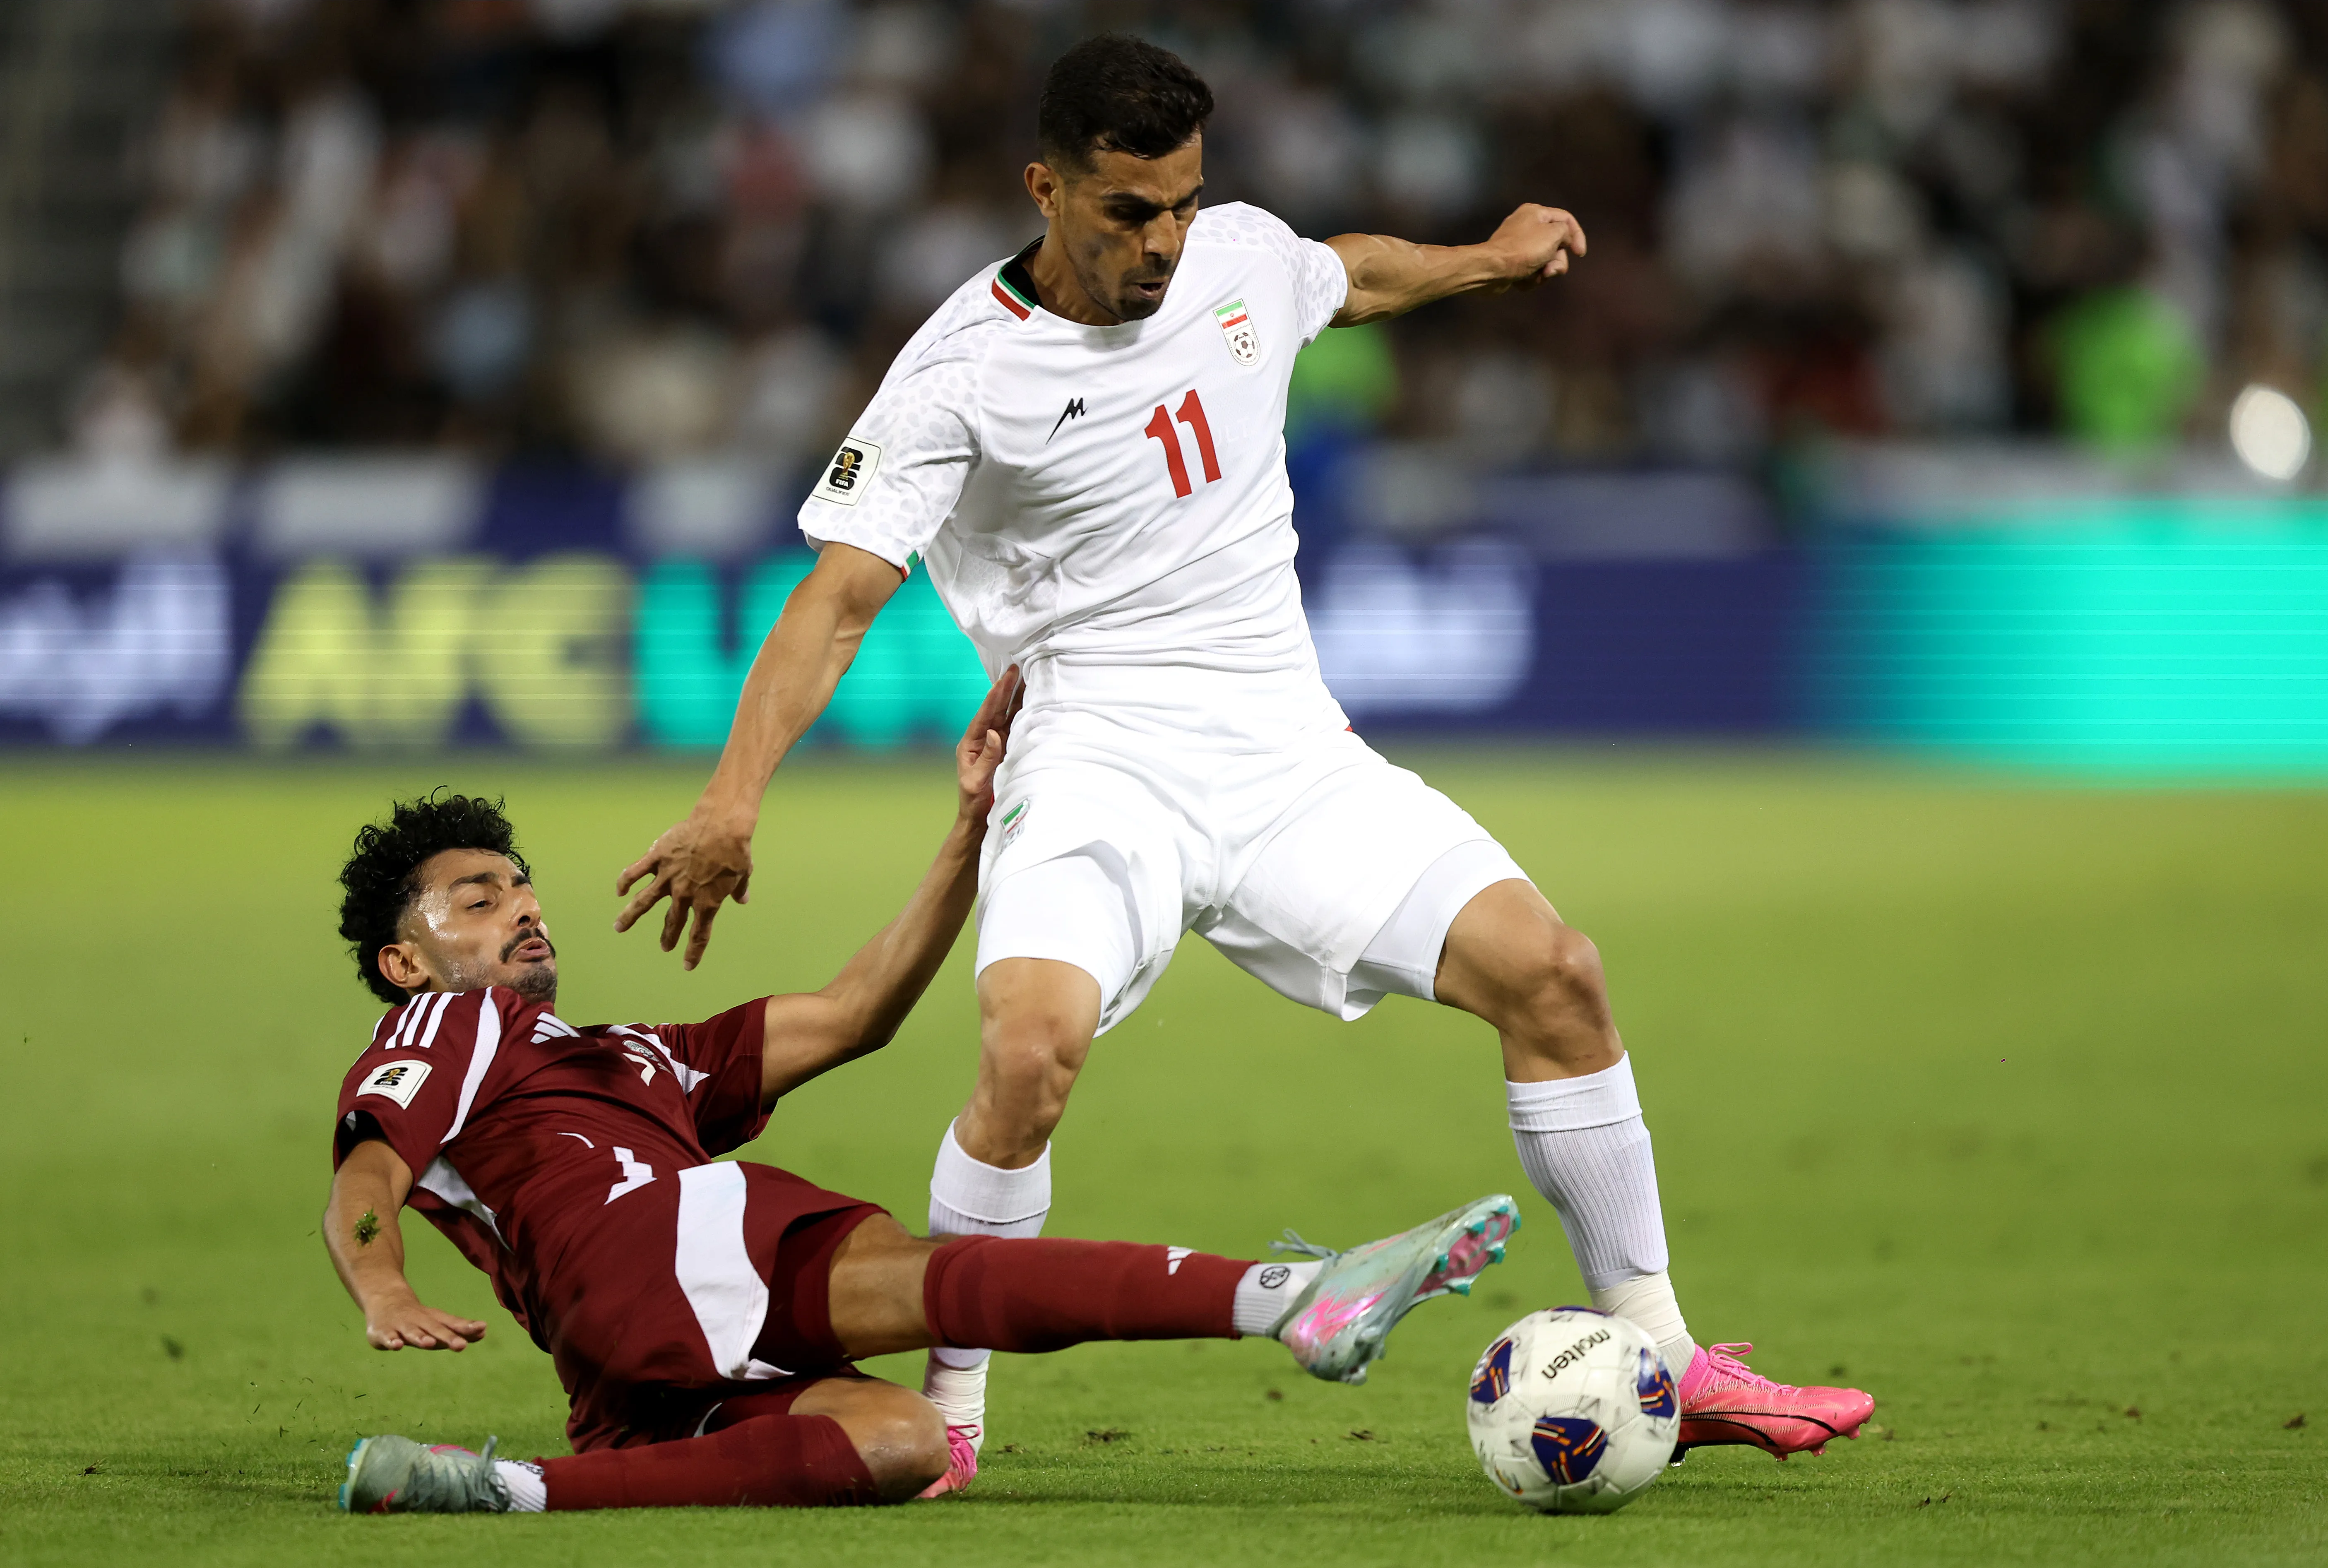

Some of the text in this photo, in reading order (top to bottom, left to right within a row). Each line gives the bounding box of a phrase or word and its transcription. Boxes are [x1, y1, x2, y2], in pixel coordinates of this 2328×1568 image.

[1145, 389, 1222, 498] 11
[835, 479, 849, 487] FIFA
[1541, 1328, 1611, 1379] molten
